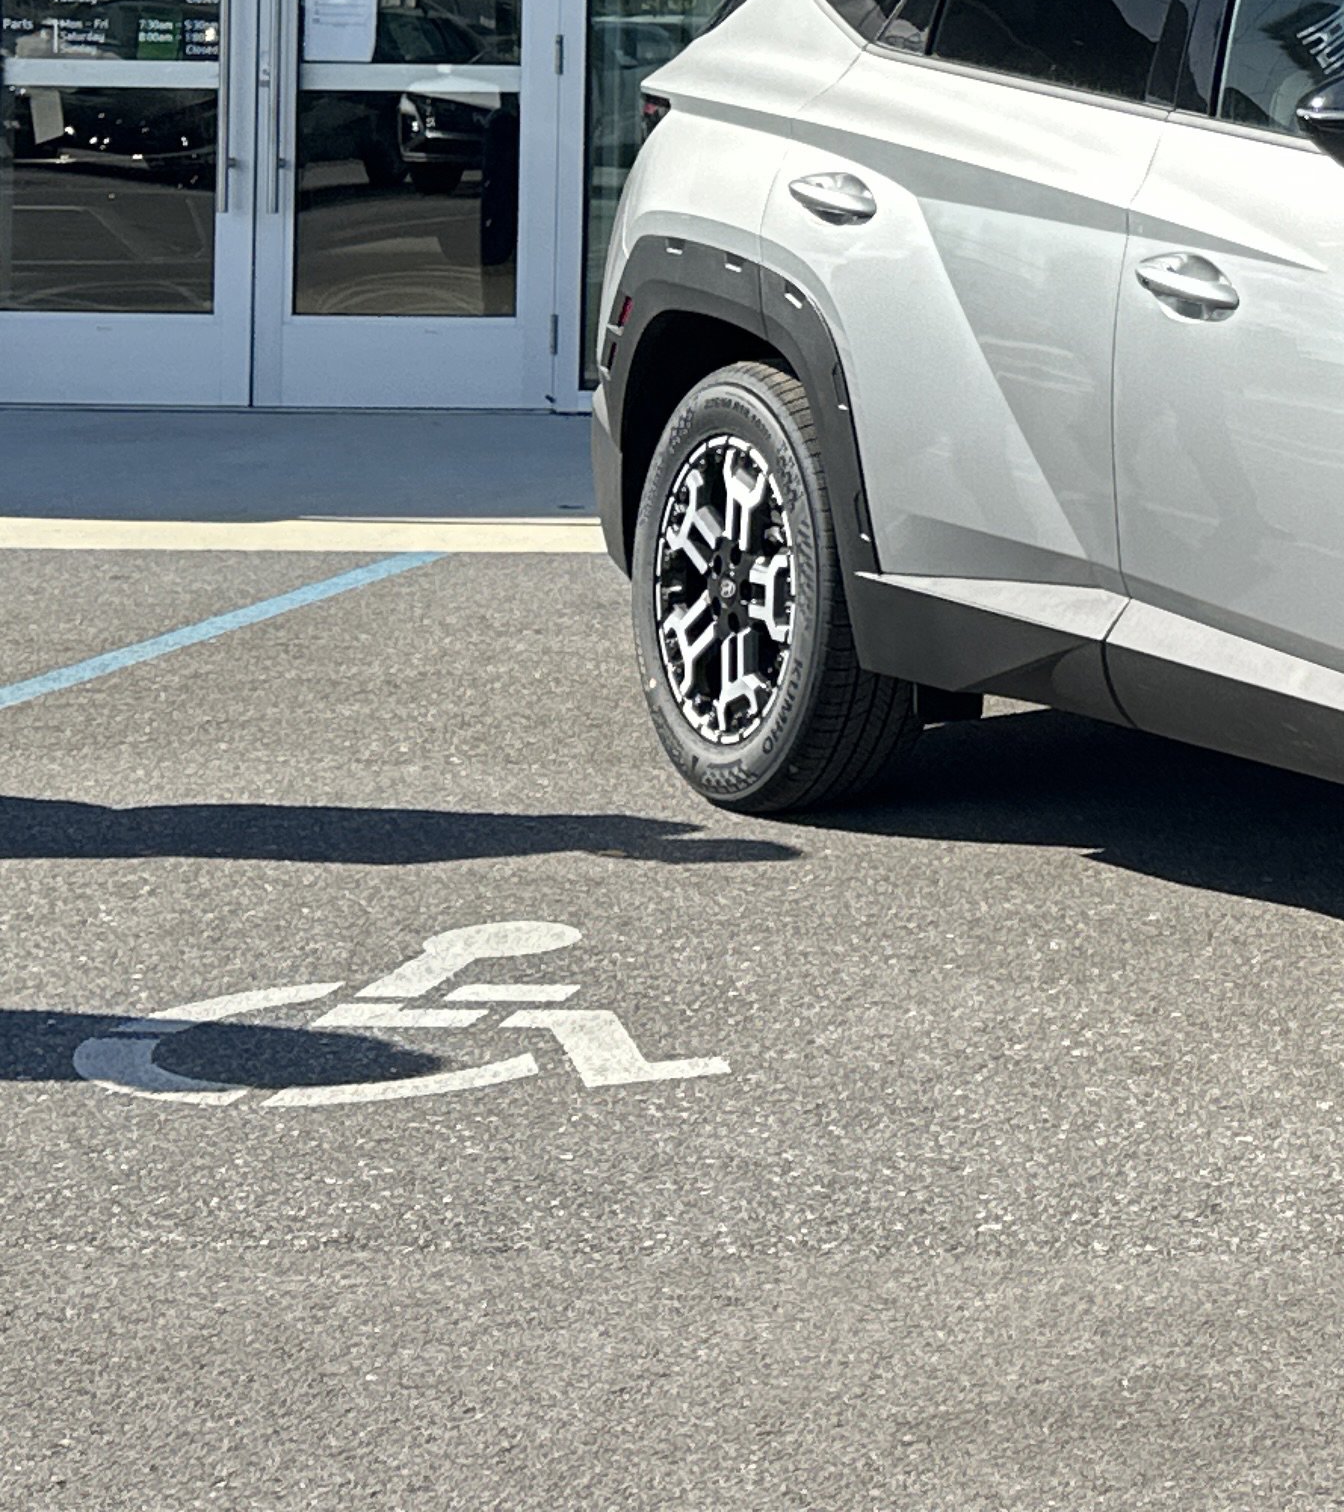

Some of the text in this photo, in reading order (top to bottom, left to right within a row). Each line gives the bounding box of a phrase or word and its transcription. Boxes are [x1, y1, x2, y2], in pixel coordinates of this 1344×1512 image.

[3, 17, 34, 29] Parts
[94, 18, 109, 28] Fri
[763, 657, 803, 754] KUMHO
